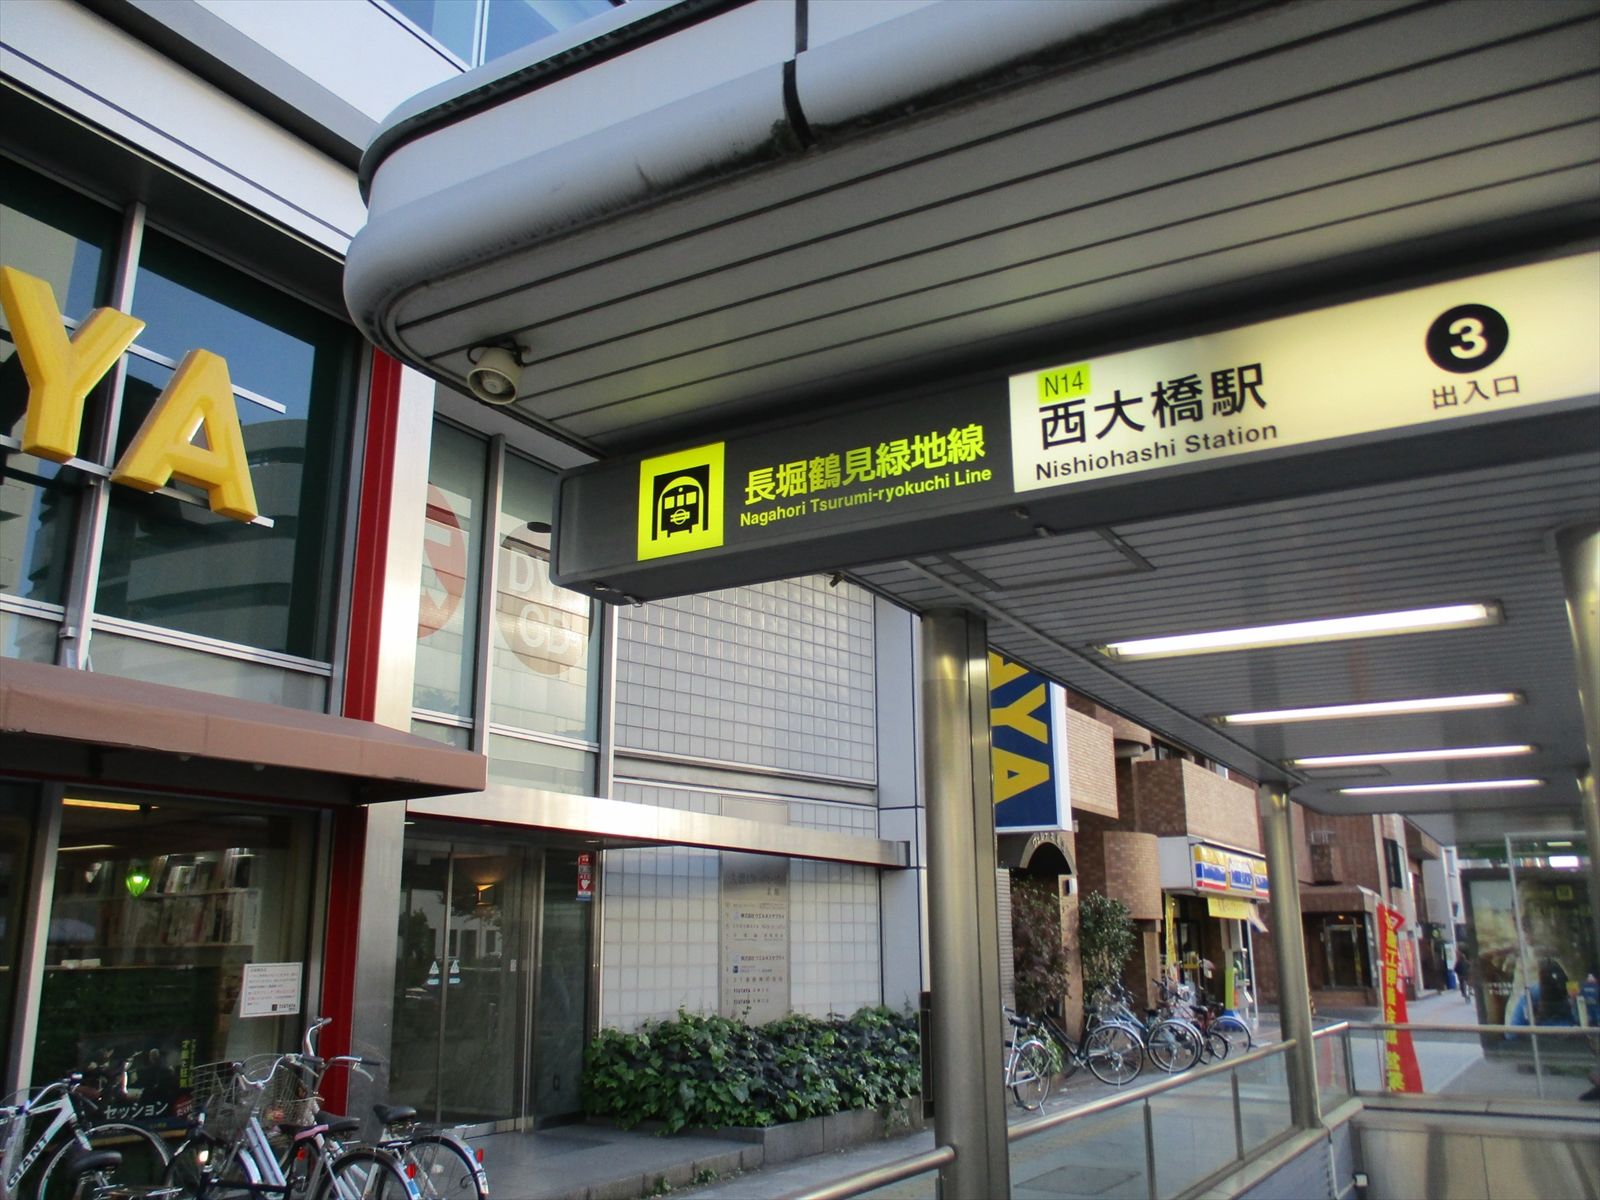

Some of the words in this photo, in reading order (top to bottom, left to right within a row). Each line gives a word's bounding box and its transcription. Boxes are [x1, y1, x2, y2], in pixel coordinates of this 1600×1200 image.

[1449, 317, 1488, 359] 3
[0, 265, 258, 523] YA
[1038, 362, 1267, 450] 西大橋駅
[1044, 370, 1084, 397] N14
[1432, 375, 1520, 409] 出入口
[745, 423, 986, 505] 長堀鶴見緑地線
[1036, 439, 1176, 481] Nishiohashi
[1185, 424, 1278, 453] Station
[740, 502, 806, 527] Nagahori
[810, 473, 950, 512] Tsurumi-ryokuchi
[955, 467, 992, 486] Line
[104, 1101, 168, 1120] セッション
[7, 1137, 48, 1188] GIANT
